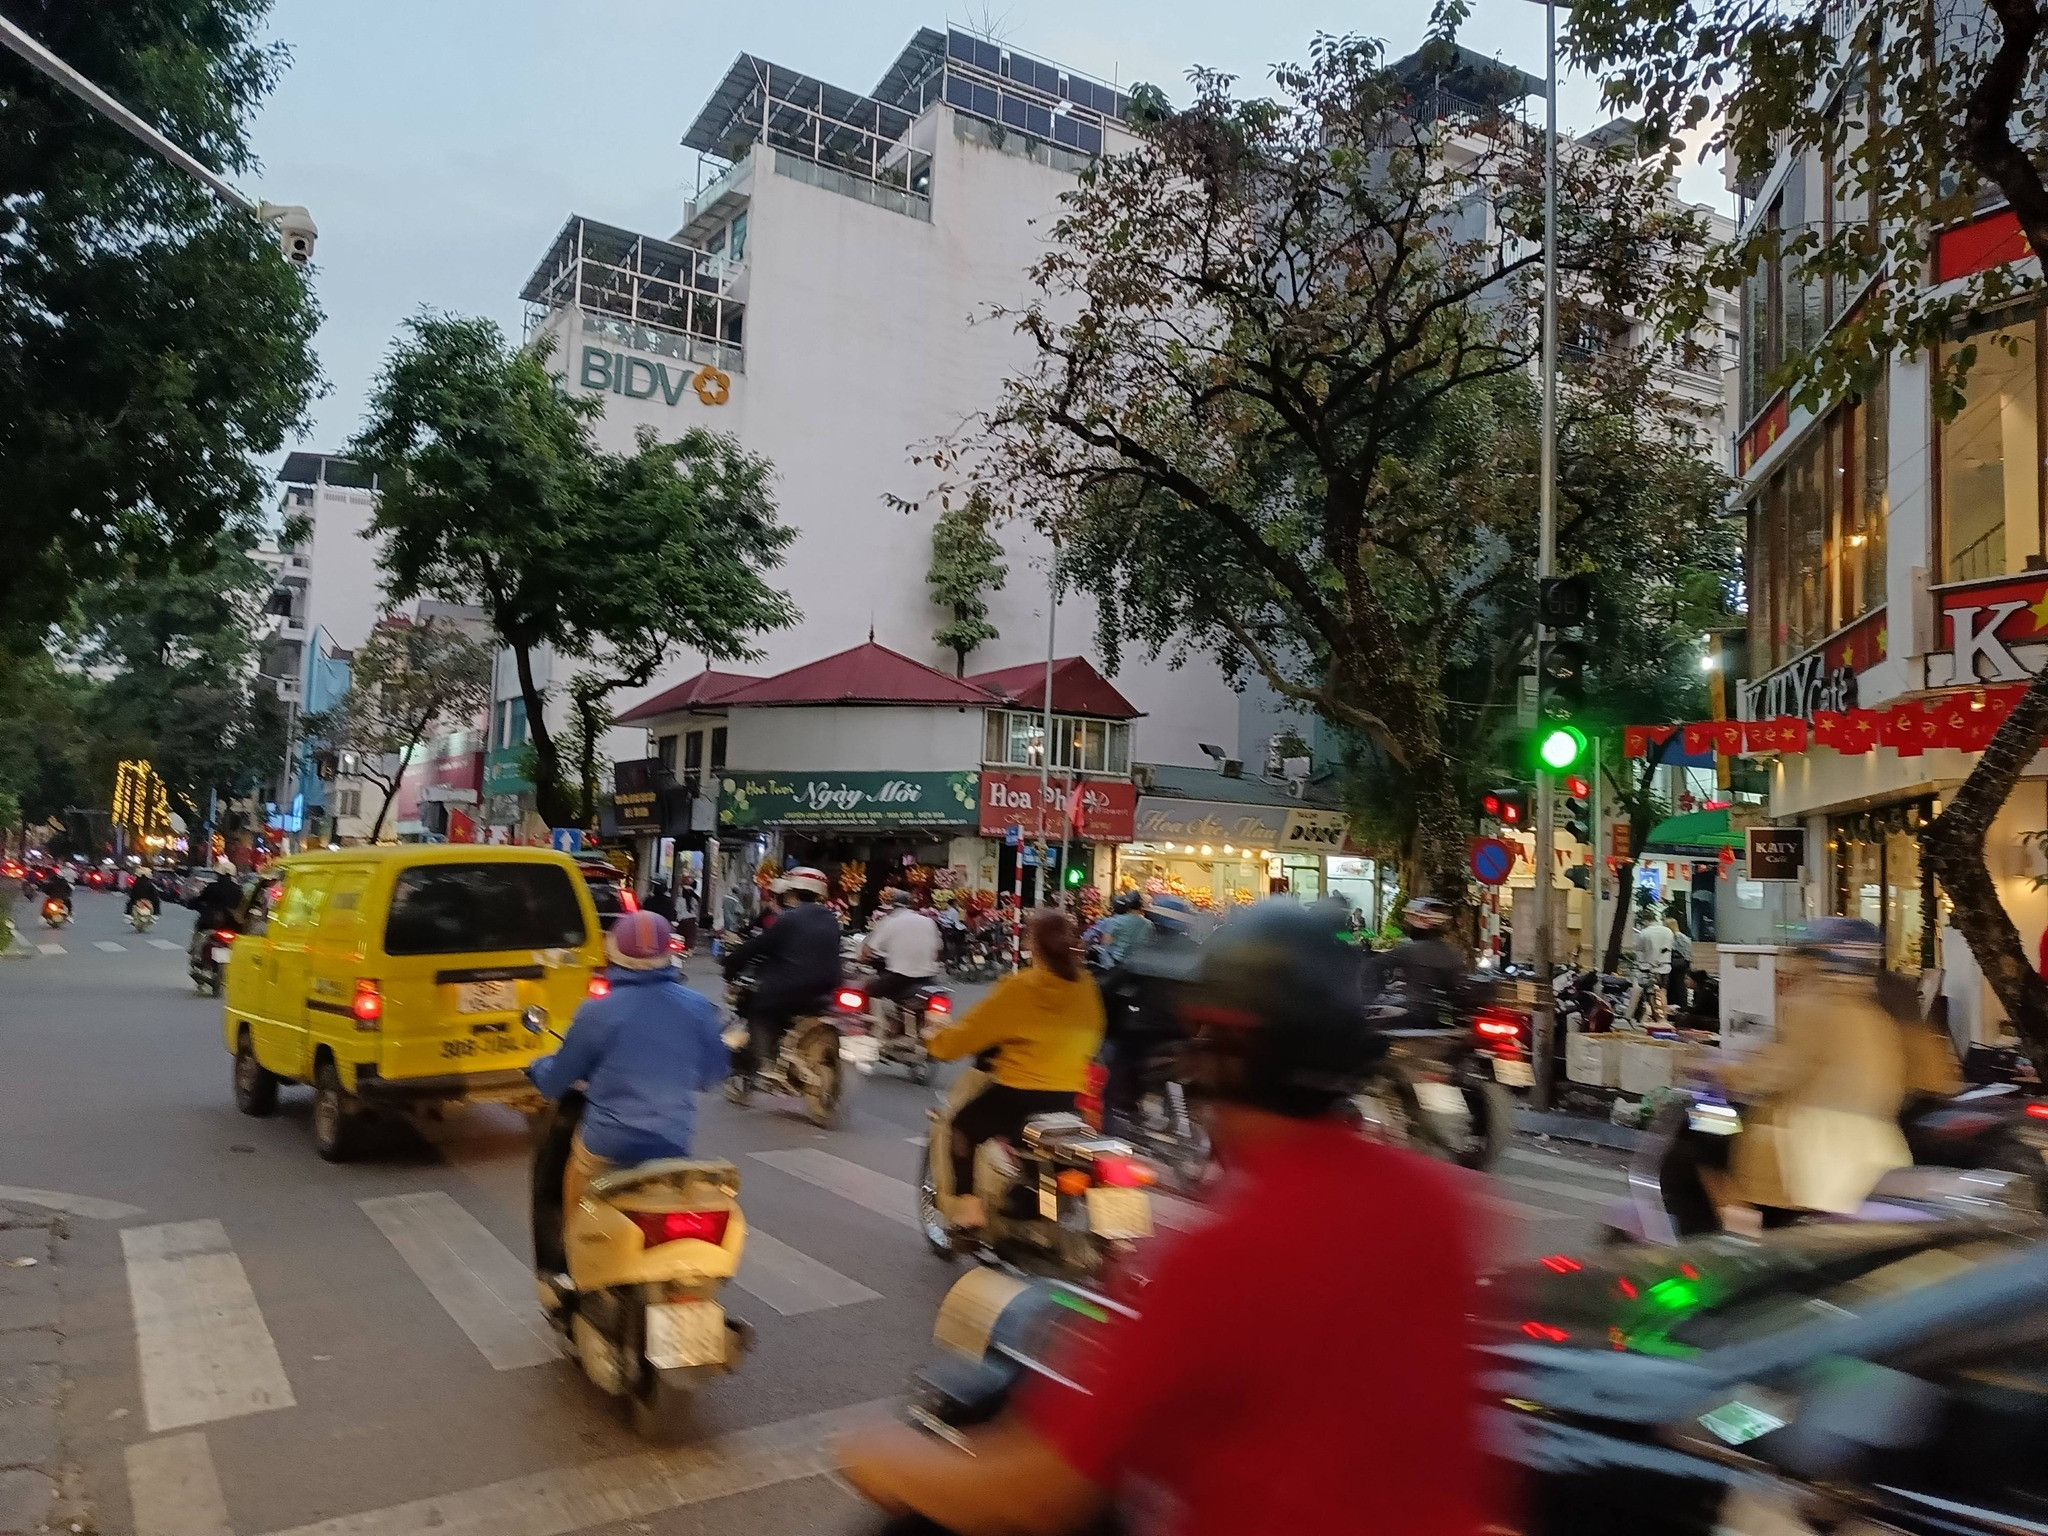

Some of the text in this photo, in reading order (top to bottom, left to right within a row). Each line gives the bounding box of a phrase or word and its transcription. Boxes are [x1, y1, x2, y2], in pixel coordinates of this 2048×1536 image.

[580, 345, 695, 406] BIDV
[1943, 600, 2036, 686] K
[1746, 656, 1813, 722] KATY
[792, 781, 866, 811] Ngày
[865, 780, 922, 802] Mới
[988, 781, 1033, 810] Hoa
[1755, 842, 1798, 853] KATY
